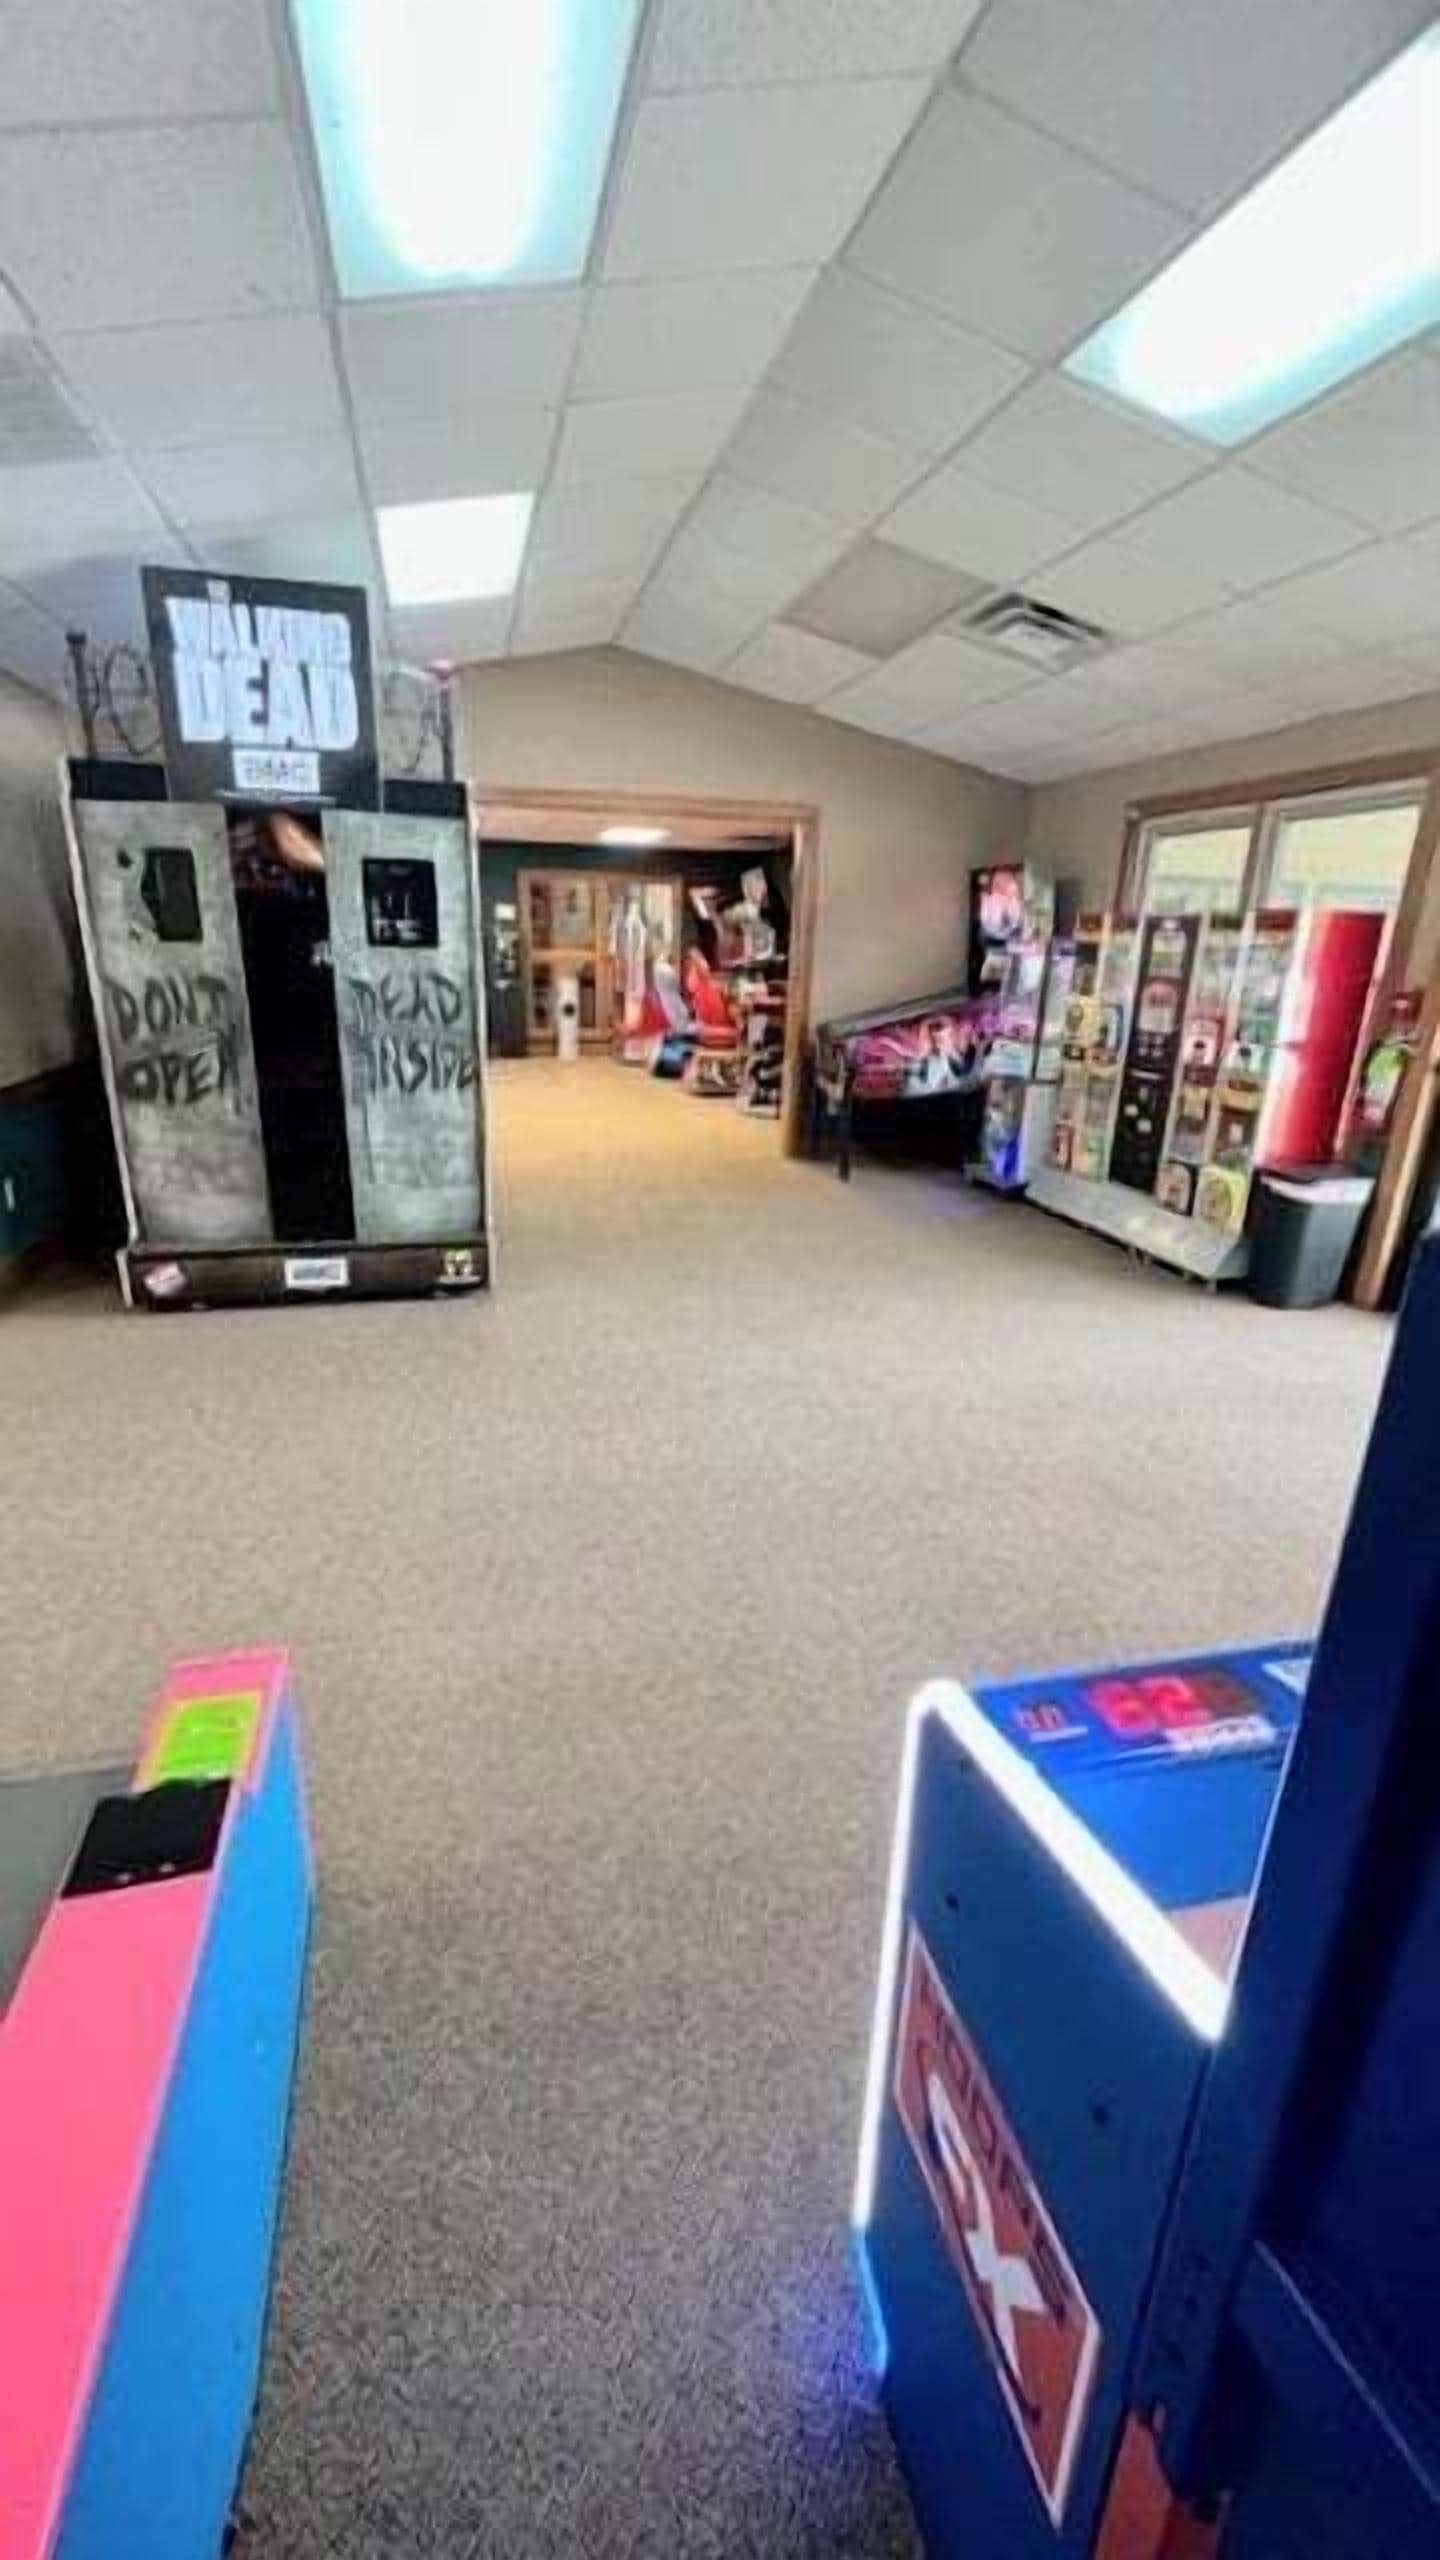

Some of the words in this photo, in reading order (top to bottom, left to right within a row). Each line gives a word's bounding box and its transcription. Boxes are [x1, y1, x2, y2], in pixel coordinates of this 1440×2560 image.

[173, 650, 360, 750] DEAD
[346, 972, 462, 1036] DEAD
[120, 1030, 243, 1113] OPEN
